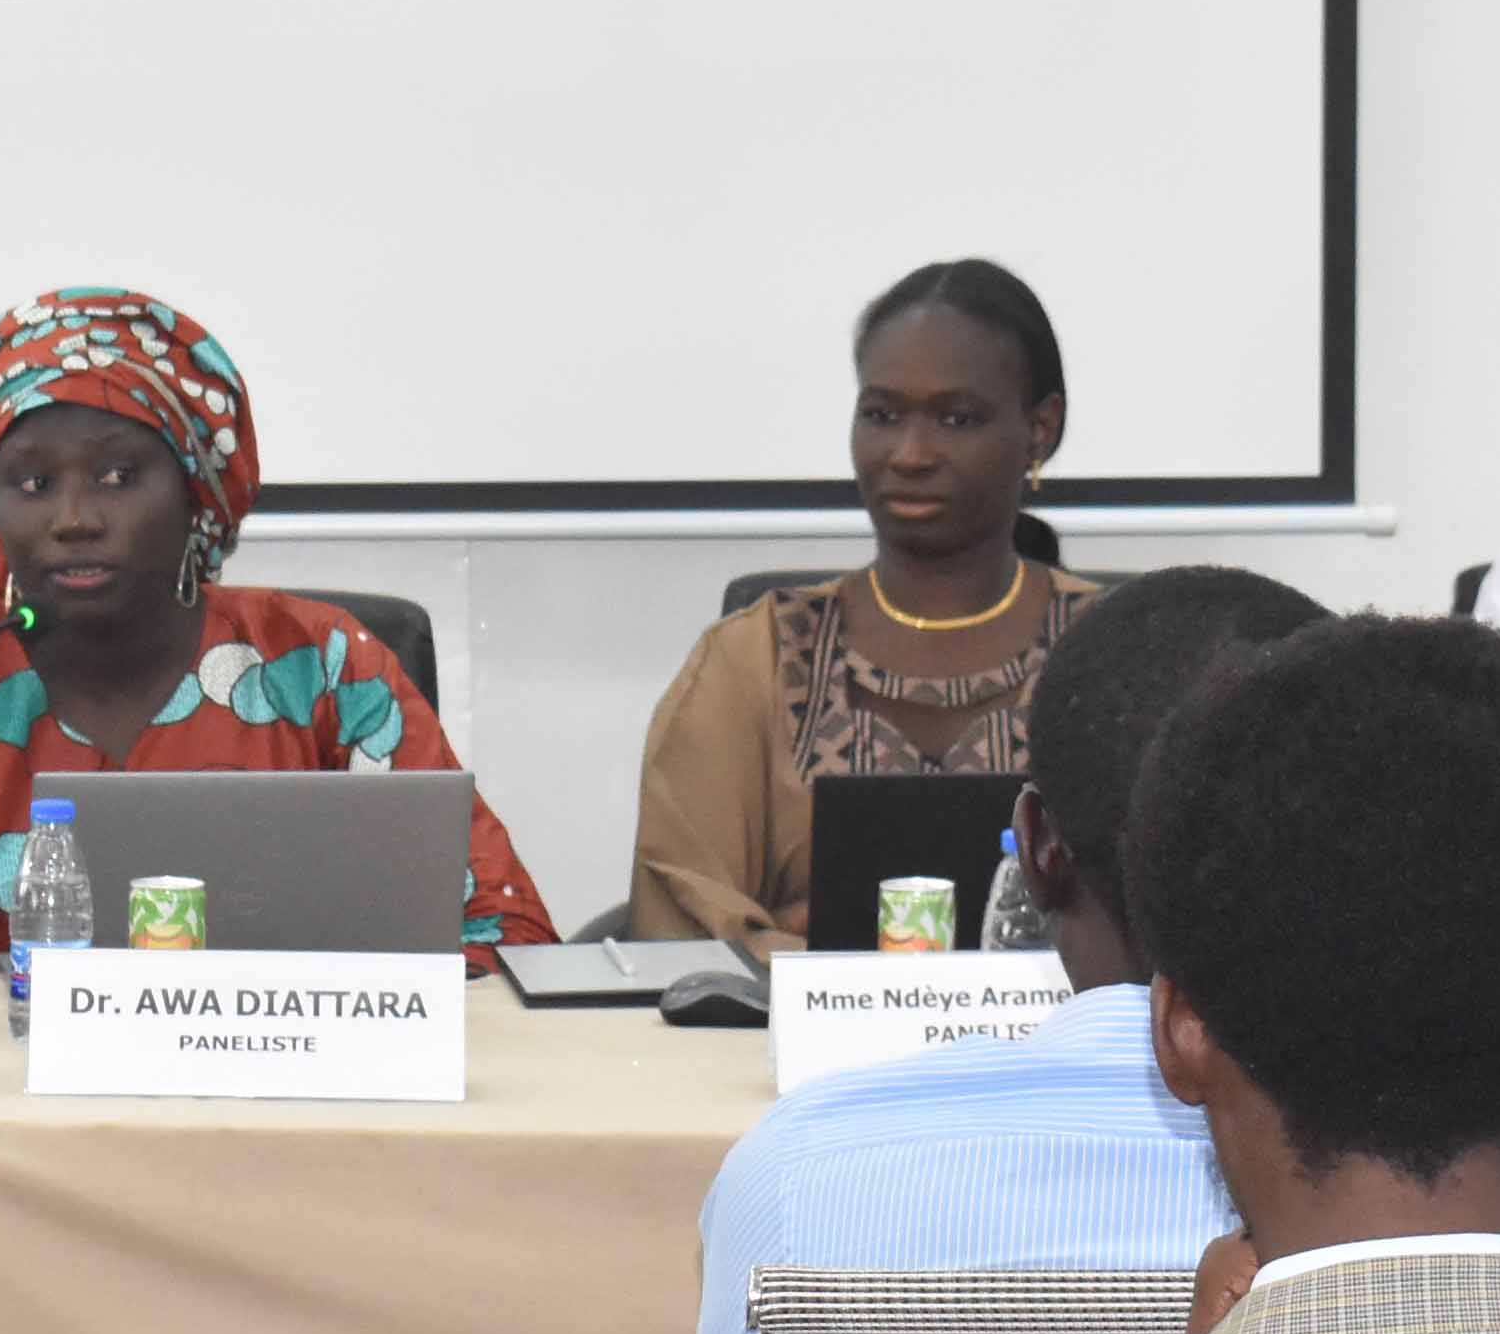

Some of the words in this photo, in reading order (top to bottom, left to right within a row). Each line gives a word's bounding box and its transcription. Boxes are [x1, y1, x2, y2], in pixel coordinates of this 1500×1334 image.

[69, 986, 121, 1014] Dr.
[135, 987, 222, 1017] AWA
[236, 988, 428, 1020] DIATTARA
[806, 988, 873, 1011] Mme
[883, 984, 971, 1012] Ndèye
[980, 986, 1071, 1007] Arame
[178, 1034, 317, 1053] PANELISTE
